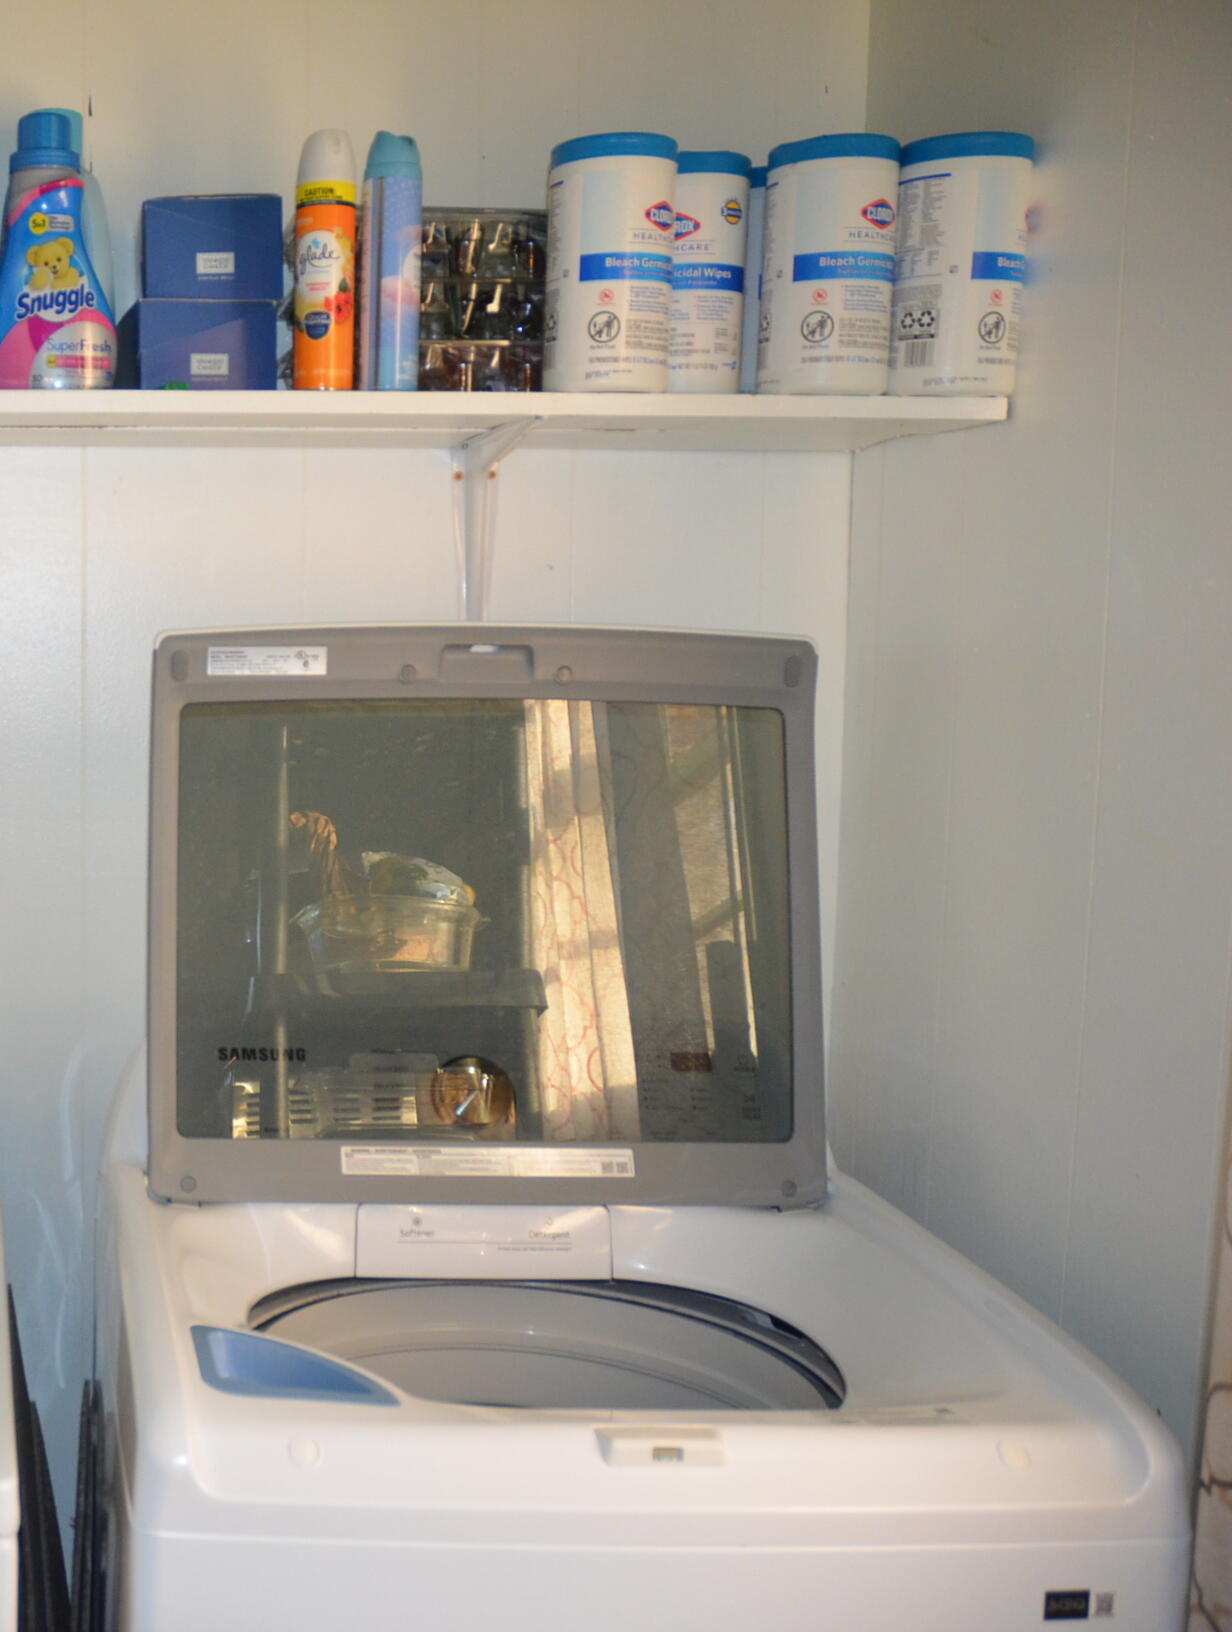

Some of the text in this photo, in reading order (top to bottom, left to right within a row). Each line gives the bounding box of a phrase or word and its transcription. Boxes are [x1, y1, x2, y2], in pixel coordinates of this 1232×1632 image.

[673, 217, 695, 232] ROX
[605, 256, 640, 269] Bleach
[818, 255, 855, 267] Bleach
[672, 267, 702, 279] icidal
[703, 268, 732, 281] Wipes
[16, 283, 95, 320] Snuggle
[218, 1047, 306, 1062] SAMSUNG
